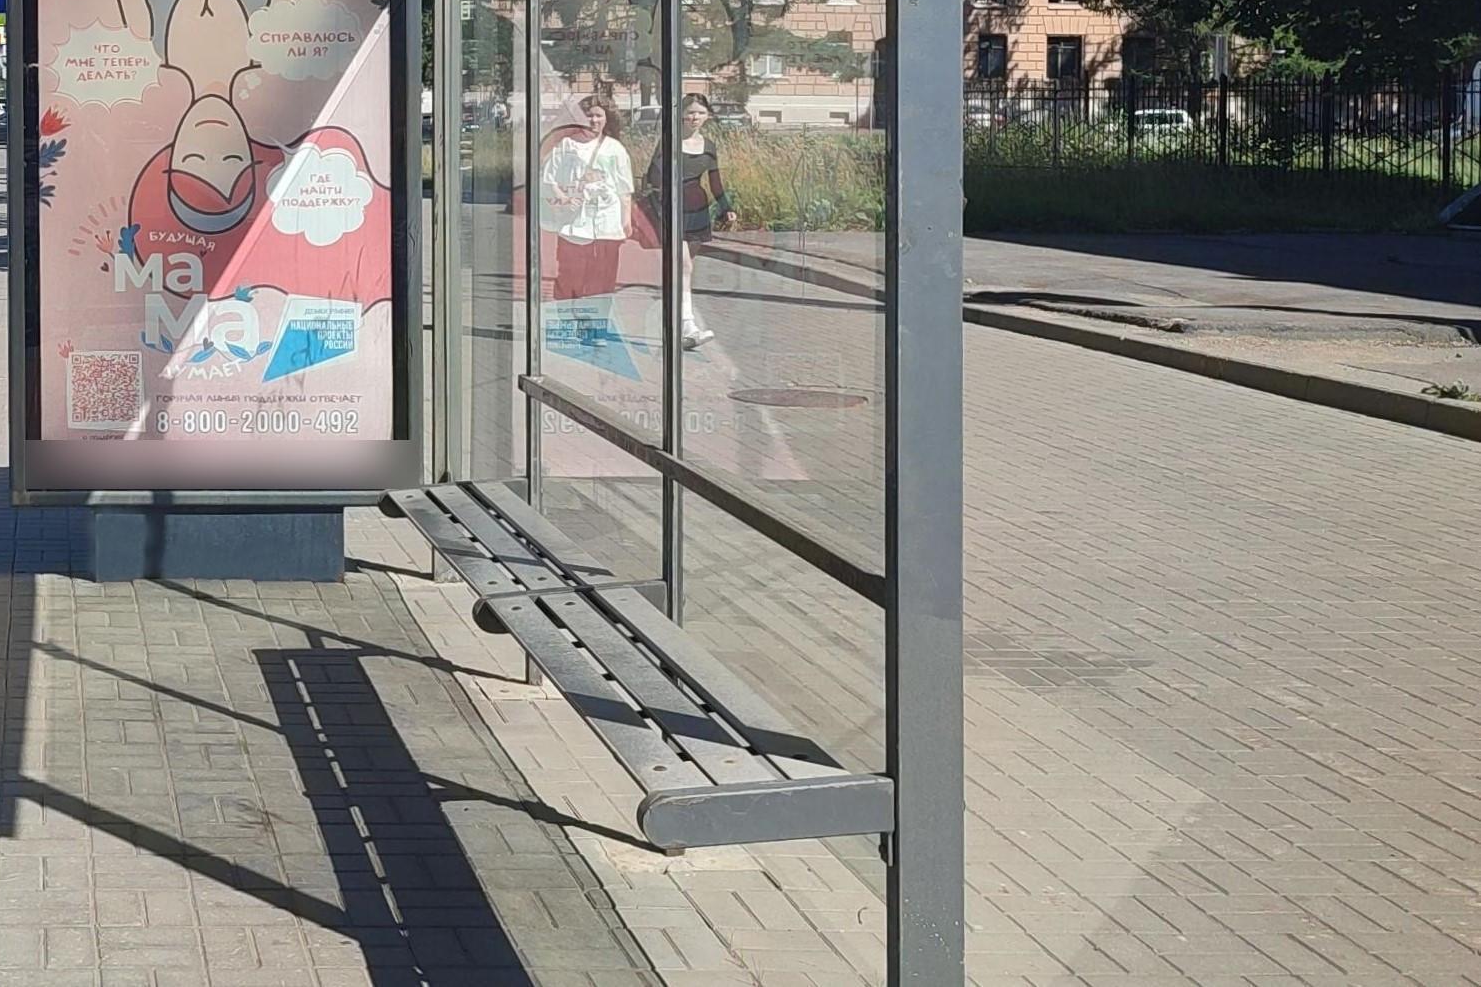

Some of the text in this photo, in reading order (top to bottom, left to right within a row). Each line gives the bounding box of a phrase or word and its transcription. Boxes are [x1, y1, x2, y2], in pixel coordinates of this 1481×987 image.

[260, 31, 355, 43] СПРАВЛЮСЬ
[94, 44, 120, 53] ЧТО
[287, 46, 329, 57] ЛИ Я?
[65, 56, 150, 67] МНЕ ТЕПЕРЬ
[76, 70, 137, 81] ДЕЛАТЬ?
[310, 174, 332, 183] ГДЕ
[300, 185, 342, 195] НАЙТИ
[282, 198, 360, 207] ПОДДЕРЖКУ?
[149, 231, 216, 251] БУДУЩАЯ
[290, 320, 353, 330] НАЦИОНАЛЬНЫЕ
[317, 330, 353, 340] ПРОЕКТЫ
[324, 340, 353, 349] РОССИИ
[158, 362, 244, 381] ДУМАЕТ
[244, 394, 306, 404] ПОДДЕРЖКИ
[309, 394, 363, 403] ОТВЕЧАЕТ
[156, 410, 359, 434] 8-800-2000-492
